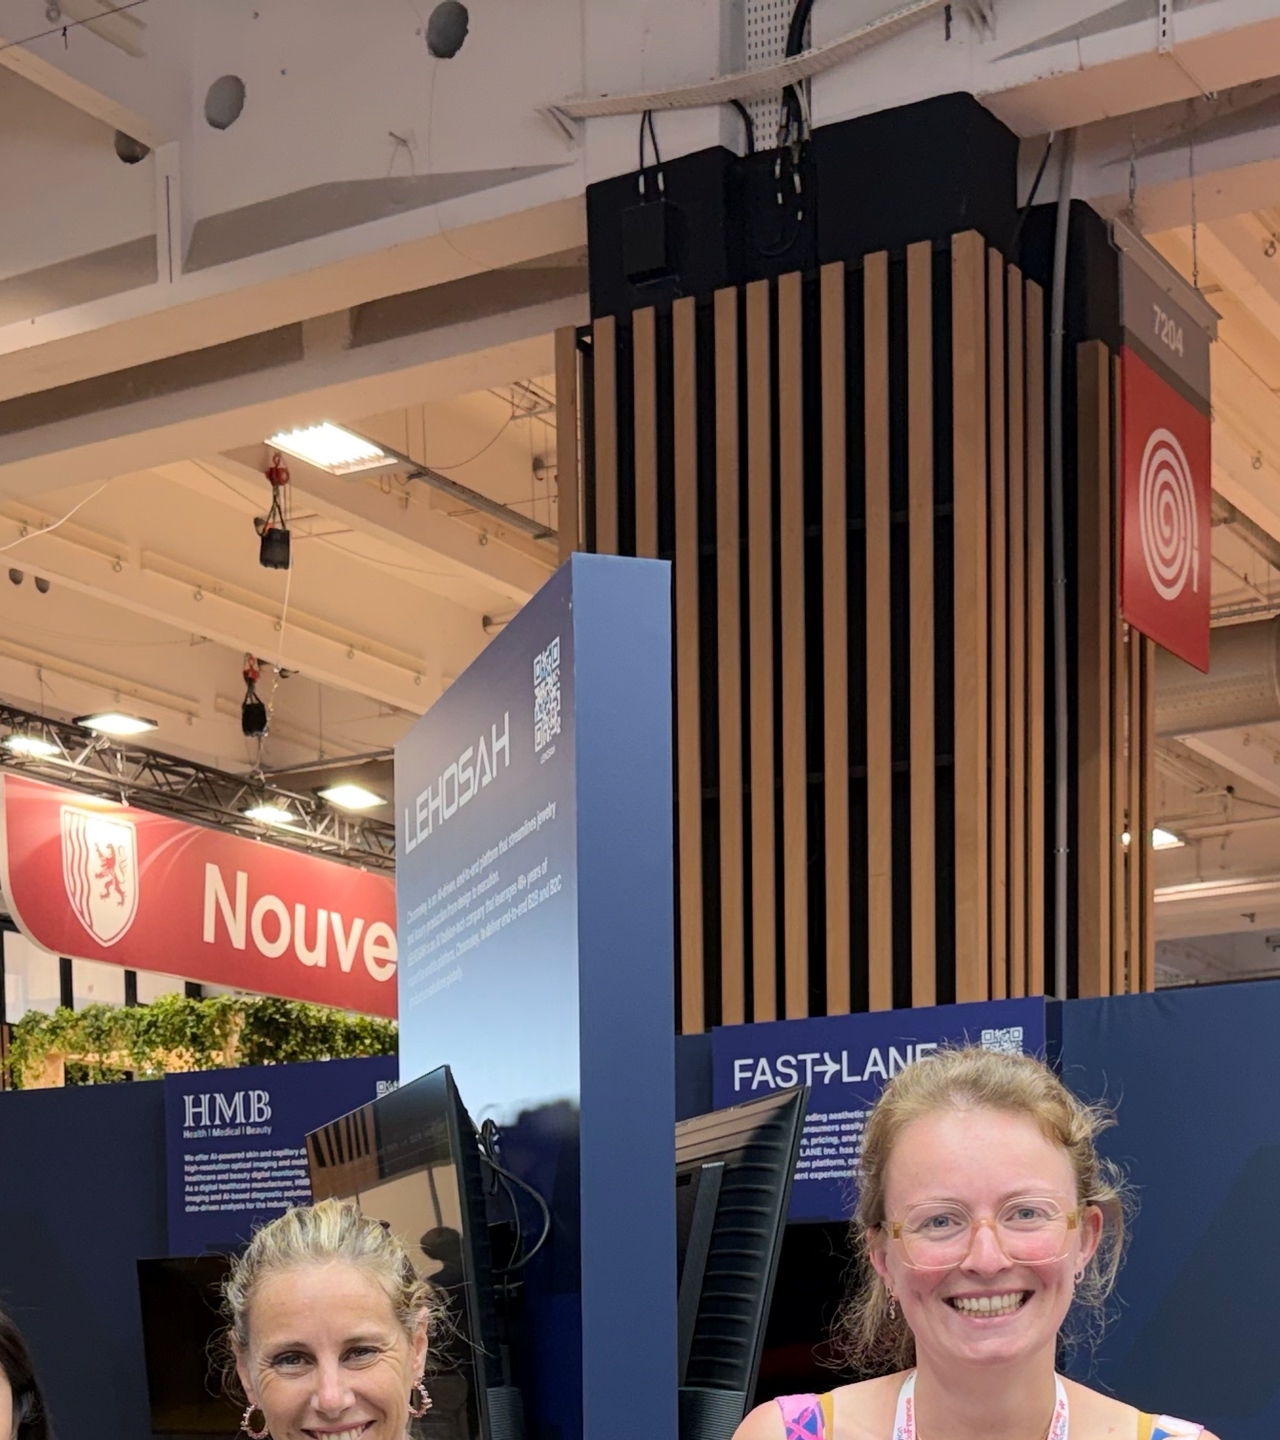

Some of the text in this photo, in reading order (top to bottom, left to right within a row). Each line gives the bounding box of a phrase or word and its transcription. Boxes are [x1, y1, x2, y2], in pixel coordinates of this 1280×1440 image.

[1153, 303, 1183, 357] 7204
[405, 711, 510, 855] LEHOSAH
[536, 801, 556, 831] jewelry
[183, 1090, 272, 1127] HMB
[828, 1111, 864, 1121] aesthetic
[183, 1125, 272, 1138] Health Medical Beauty
[841, 1122, 864, 1132] easily
[811, 1134, 857, 1146] pricing, and
[210, 1151, 245, 1161] AI-powered
[246, 1150, 259, 1158] skin
[260, 1149, 271, 1157] and
[272, 1148, 298, 1157] capillary
[824, 1146, 853, 1156] Inc. has
[184, 1159, 290, 1173] high-resolution optical imaging and
[812, 1157, 847, 1168] platform,
[230, 1172, 250, 1181] beauty
[251, 1171, 270, 1180] digital
[810, 1169, 856, 1180] experiences
[199, 1184, 218, 1193] digital
[219, 1182, 250, 1190] healthcare
[222, 1192, 250, 1200] AI-based
[251, 1191, 282, 1200] diagnostic
